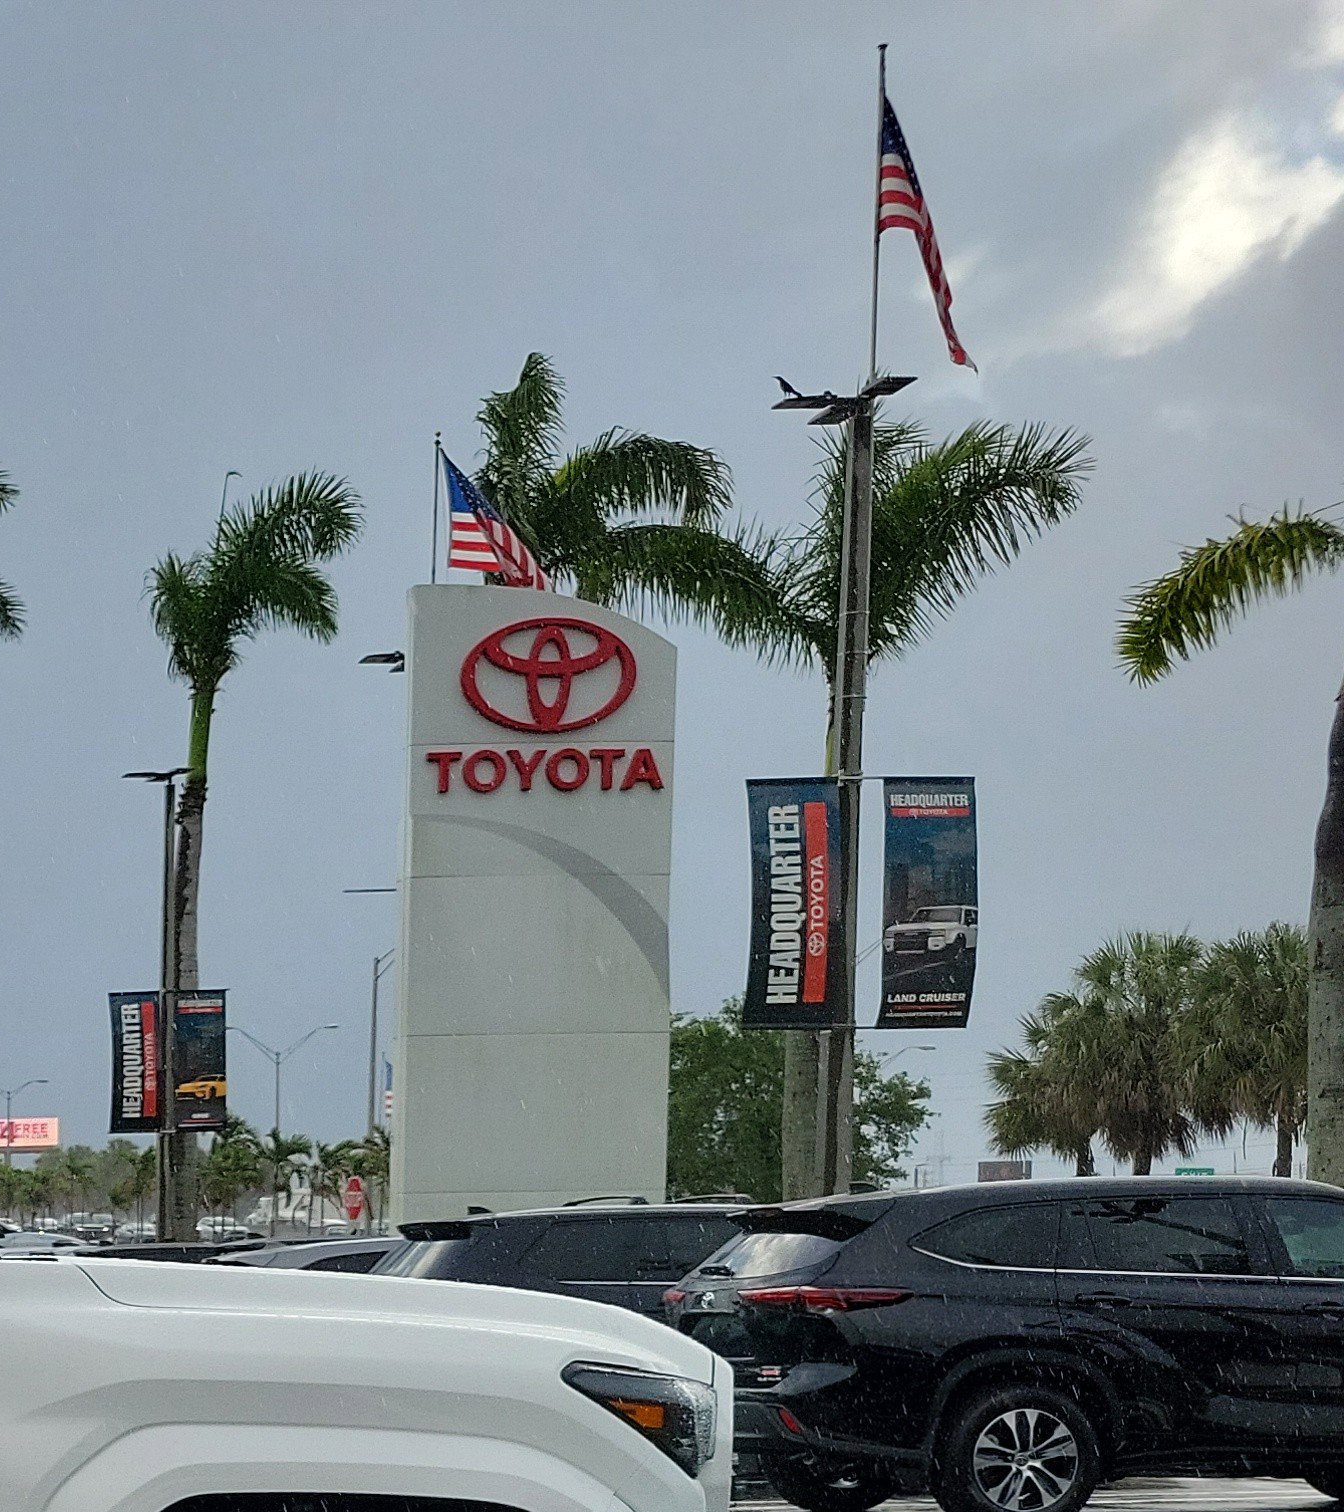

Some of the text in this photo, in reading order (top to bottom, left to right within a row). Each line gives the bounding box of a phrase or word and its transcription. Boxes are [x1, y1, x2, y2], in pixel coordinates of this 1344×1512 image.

[425, 748, 665, 794] TOYOTA
[890, 793, 969, 808] HEADQUARTER
[765, 803, 807, 1004] HEADQUARTER
[810, 855, 825, 931] TOYOTA
[887, 992, 966, 1003] LAND CRUISER
[120, 1003, 144, 1118] HEADQUARTER
[15, 1123, 48, 1133] FREE
